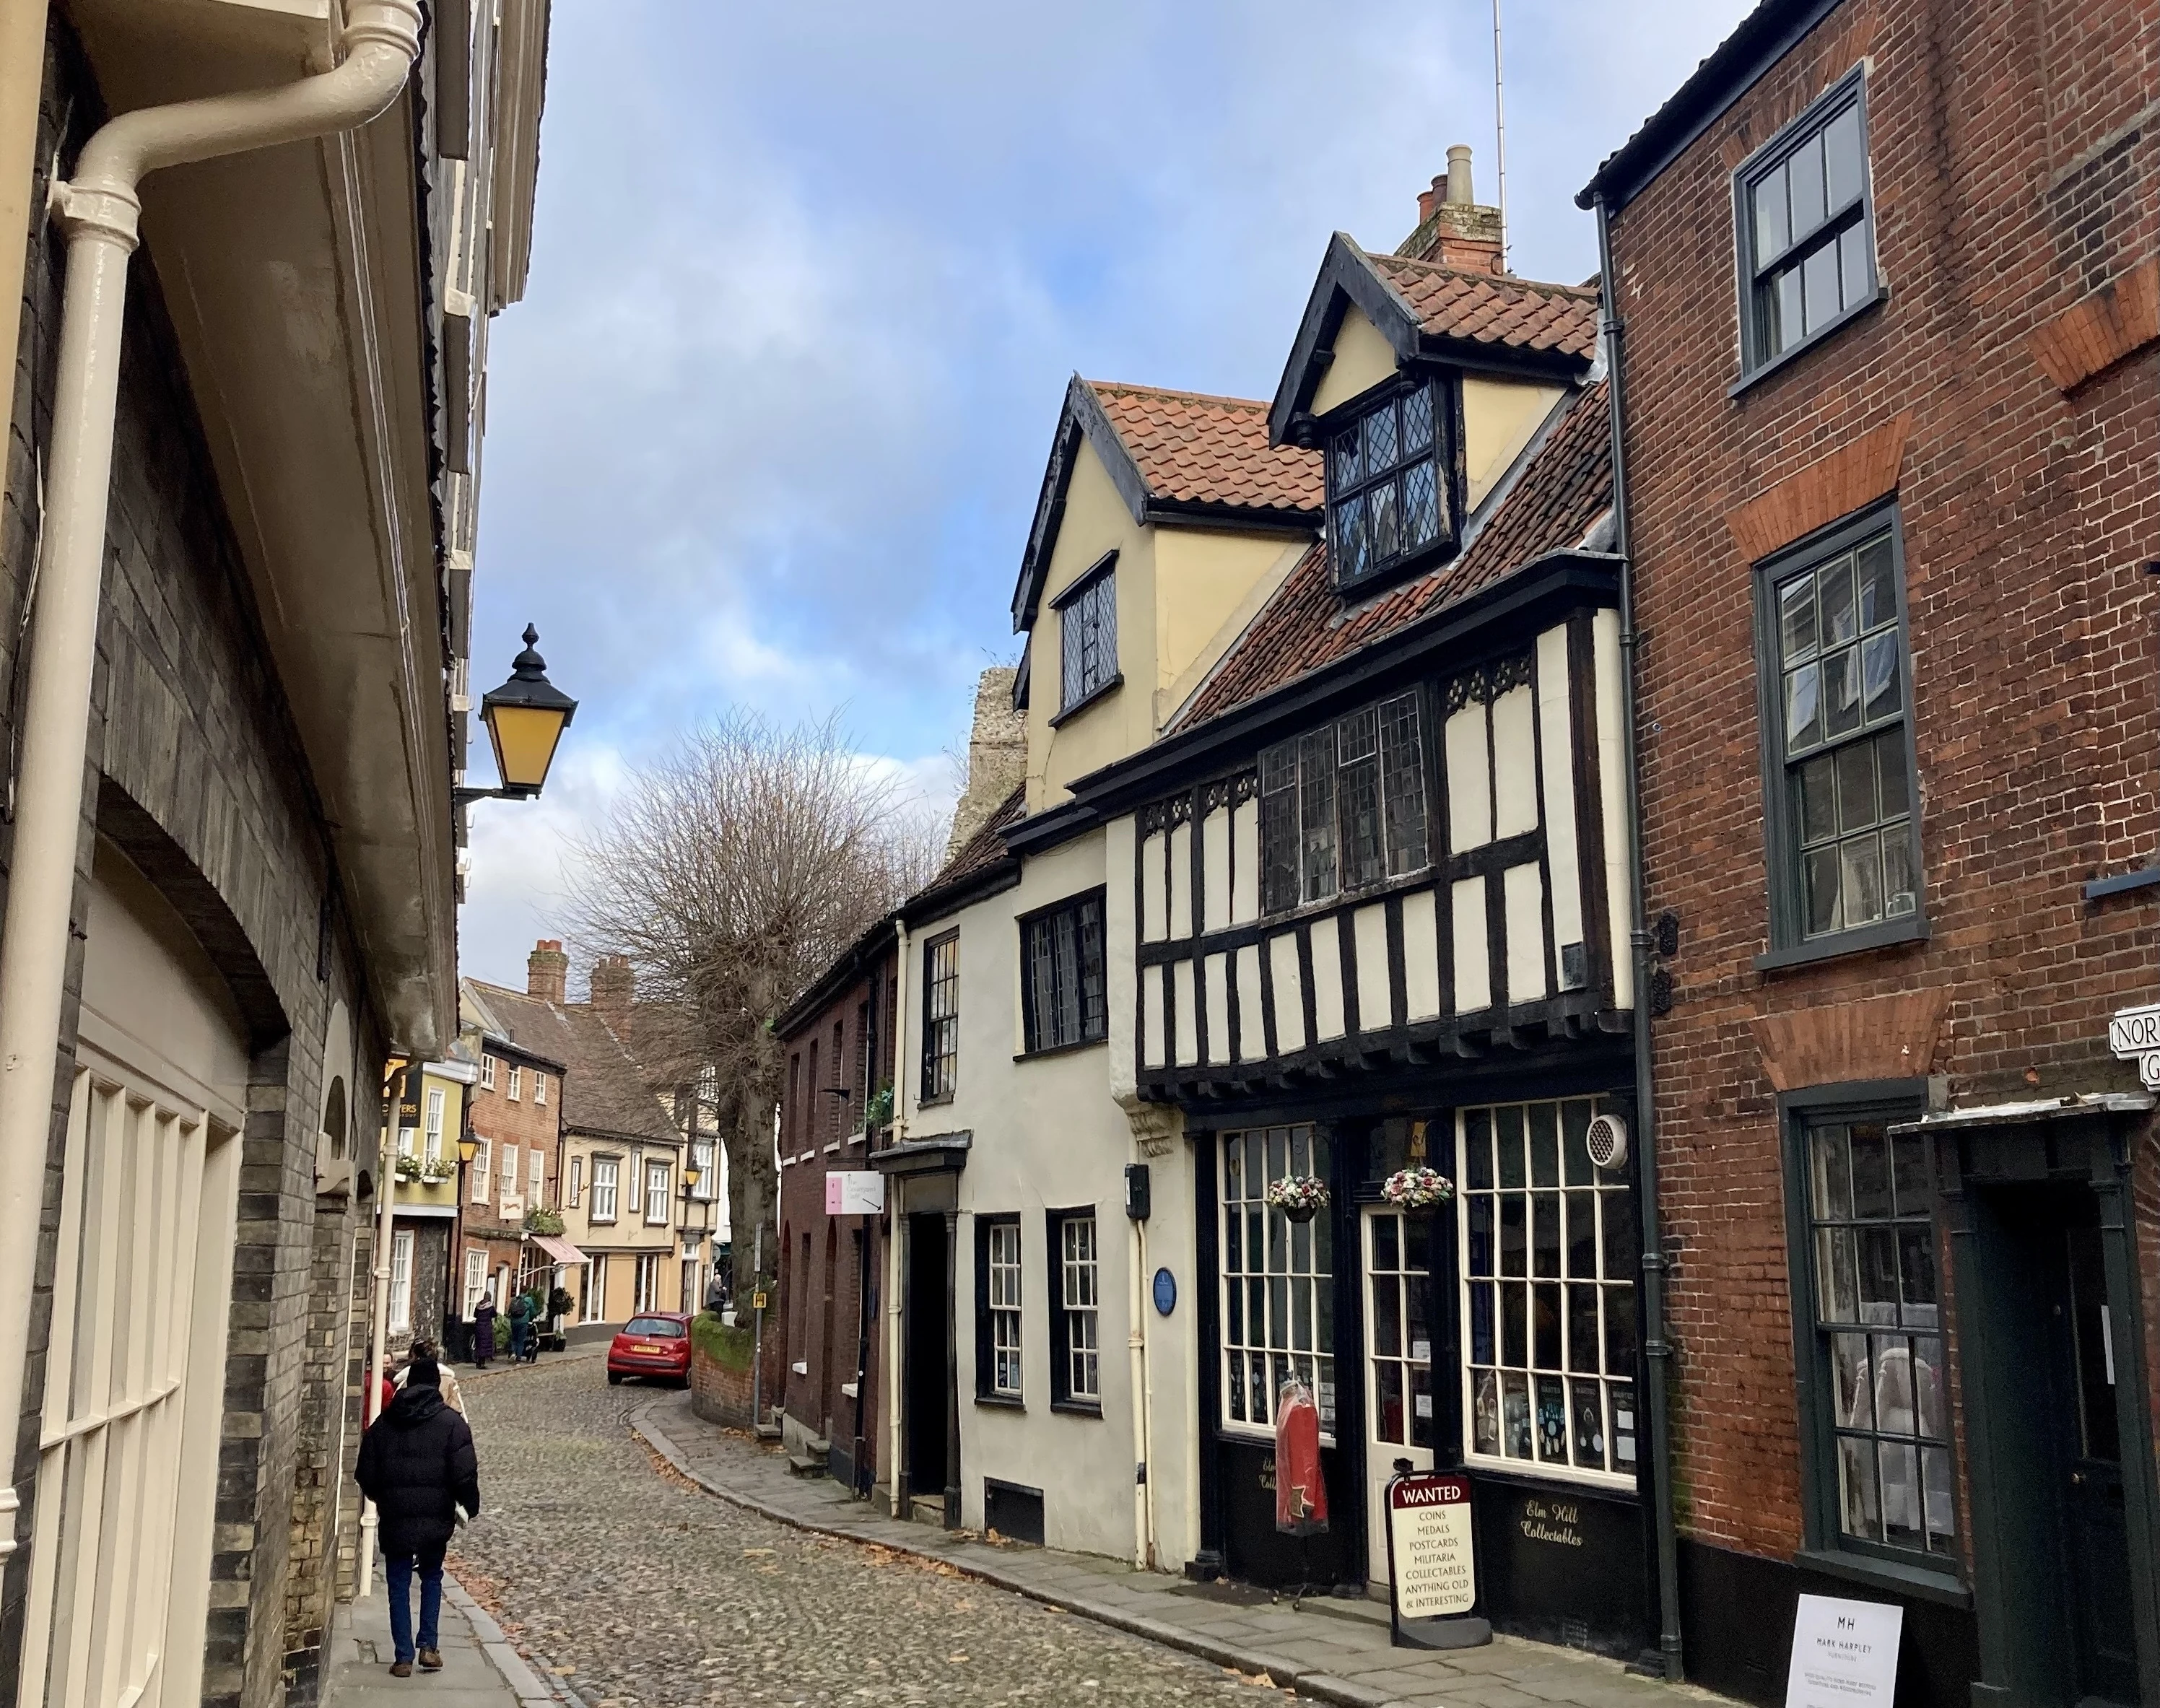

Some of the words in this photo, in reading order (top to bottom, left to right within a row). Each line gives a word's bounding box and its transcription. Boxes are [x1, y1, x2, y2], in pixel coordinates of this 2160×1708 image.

[2117, 1016, 2160, 1047] NOR
[1402, 1486, 1461, 1504] WANTED
[1419, 1510, 1447, 1521] COINS
[1526, 1500, 1546, 1518] Elm
[1551, 1504, 1579, 1524] Hill
[1417, 1525, 1450, 1535] MEDALS
[1520, 1520, 1583, 1546] Collectables
[1409, 1538, 1458, 1551] POSTCARDS
[1414, 1553, 1456, 1565] MILITARIA
[1406, 1566, 1466, 1580] COLLECTABLES
[1405, 1582, 1450, 1595] ANYTHING
[1452, 1580, 1469, 1589] OLD
[1406, 1600, 1414, 1609] &
[1416, 1593, 1469, 1608] INTERESTING
[1816, 1637, 1836, 1648] MARK
